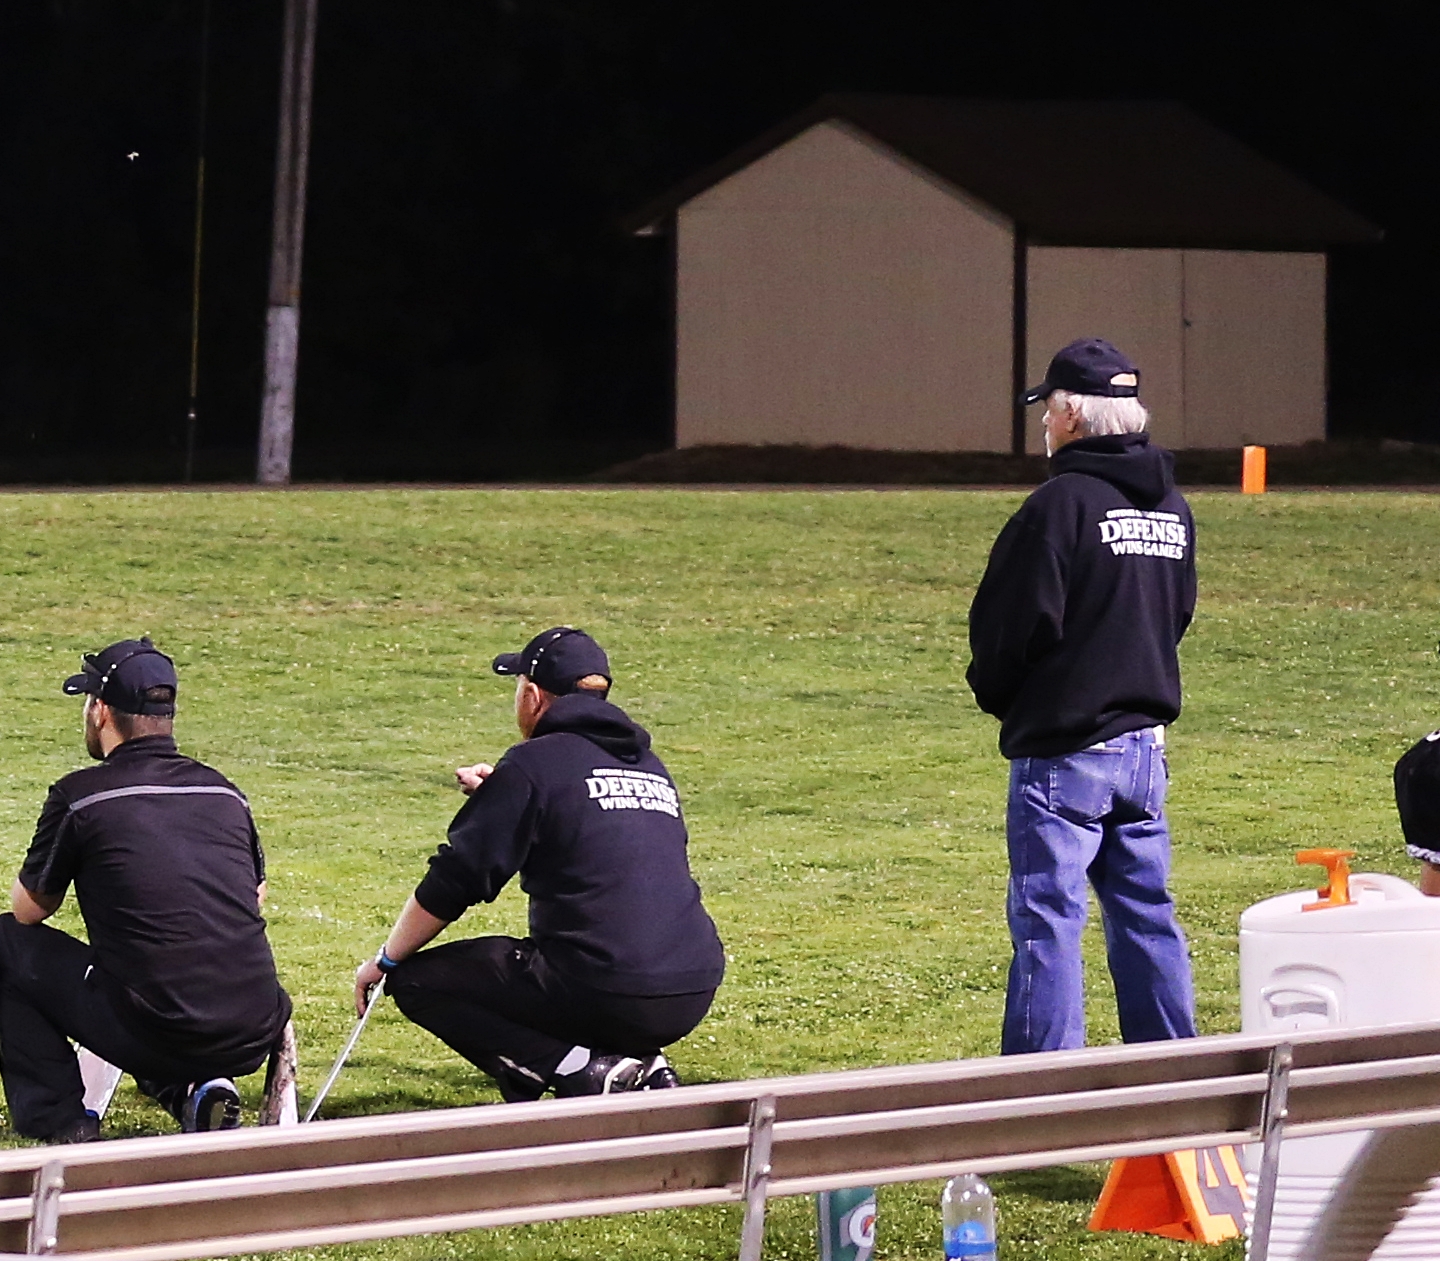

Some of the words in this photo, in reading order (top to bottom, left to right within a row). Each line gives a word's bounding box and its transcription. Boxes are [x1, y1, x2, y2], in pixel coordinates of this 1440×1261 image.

[1098, 518, 1187, 547] DEFENSE
[1110, 540, 1144, 556] WINS
[1143, 541, 1184, 560] GAMES
[584, 776, 679, 808] DEFENSE
[598, 796, 641, 811] WINS
